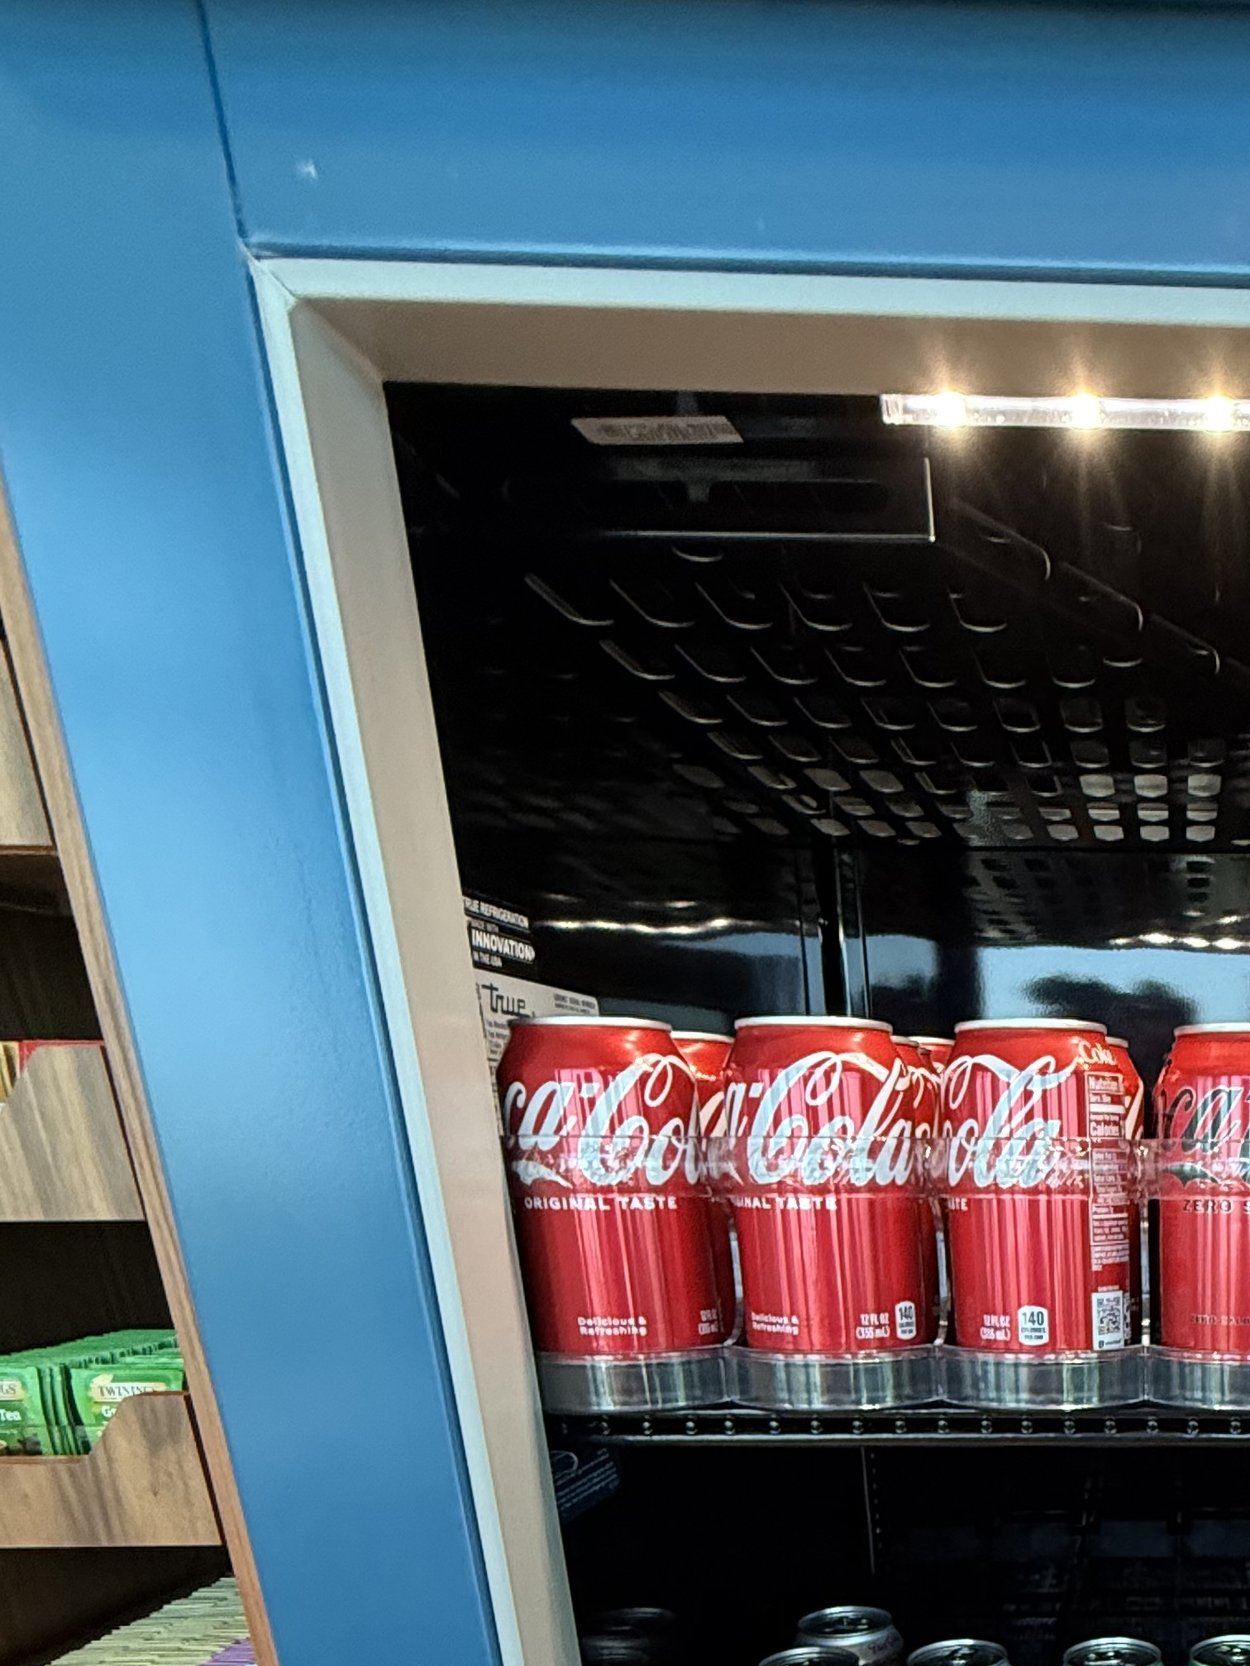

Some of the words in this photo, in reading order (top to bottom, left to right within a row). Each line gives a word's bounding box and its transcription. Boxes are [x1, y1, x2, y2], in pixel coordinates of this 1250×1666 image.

[472, 929, 534, 961] INNOVATION
[524, 1194, 610, 1211] ORIGINAL
[620, 1193, 678, 1211] TASTE
[775, 1196, 837, 1211] TASTE
[1183, 1200, 1232, 1213] ZERO
[577, 1315, 635, 1327] Delicious
[1021, 1310, 1045, 1327] 140
[579, 1325, 647, 1337] Refreshing
